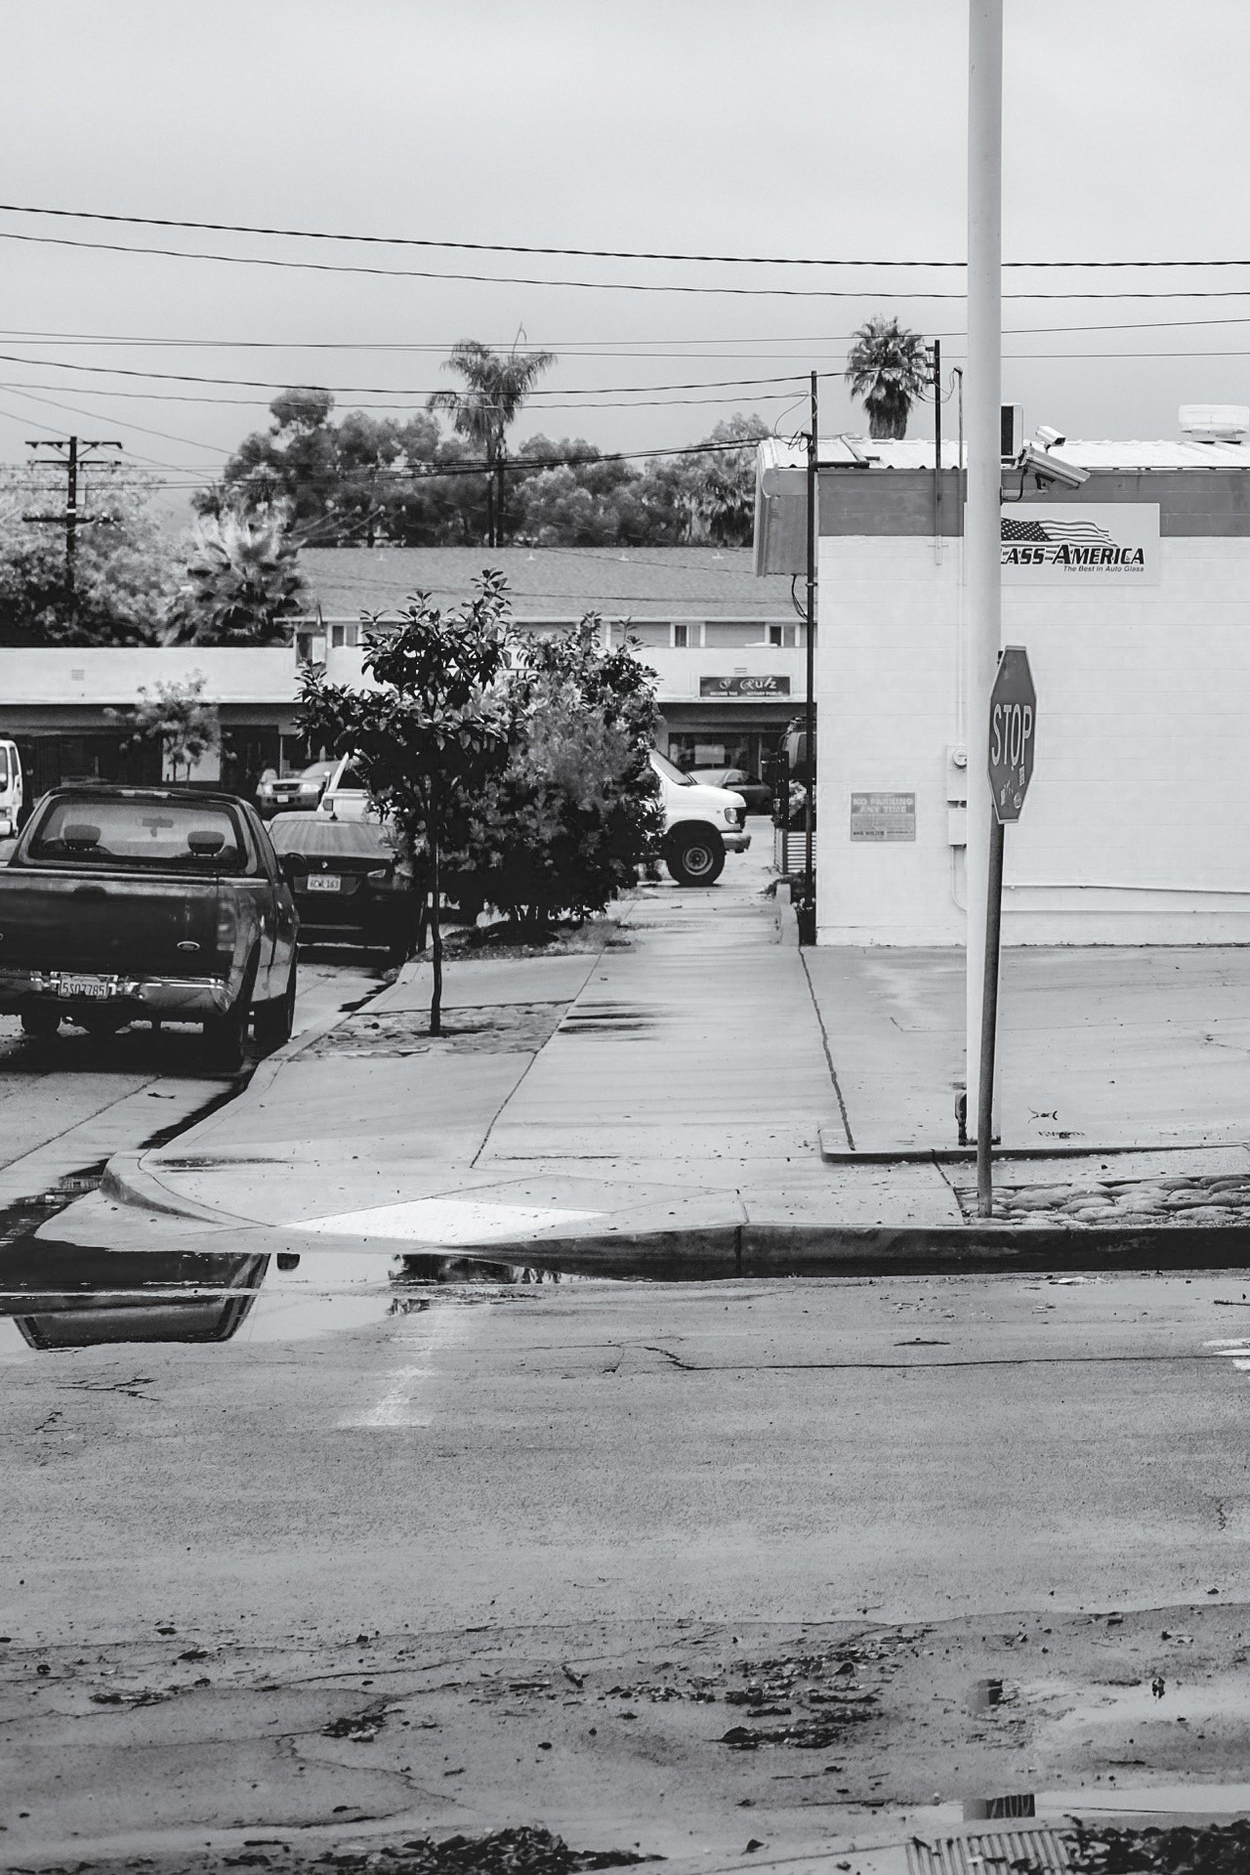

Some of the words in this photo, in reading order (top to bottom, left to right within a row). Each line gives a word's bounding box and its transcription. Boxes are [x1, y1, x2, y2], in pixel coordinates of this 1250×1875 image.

[991, 704, 1032, 765] STOP
[852, 797, 868, 806] NO
[870, 797, 914, 806] PARKING
[859, 805, 880, 813] ANY
[882, 805, 907, 813] TIME
